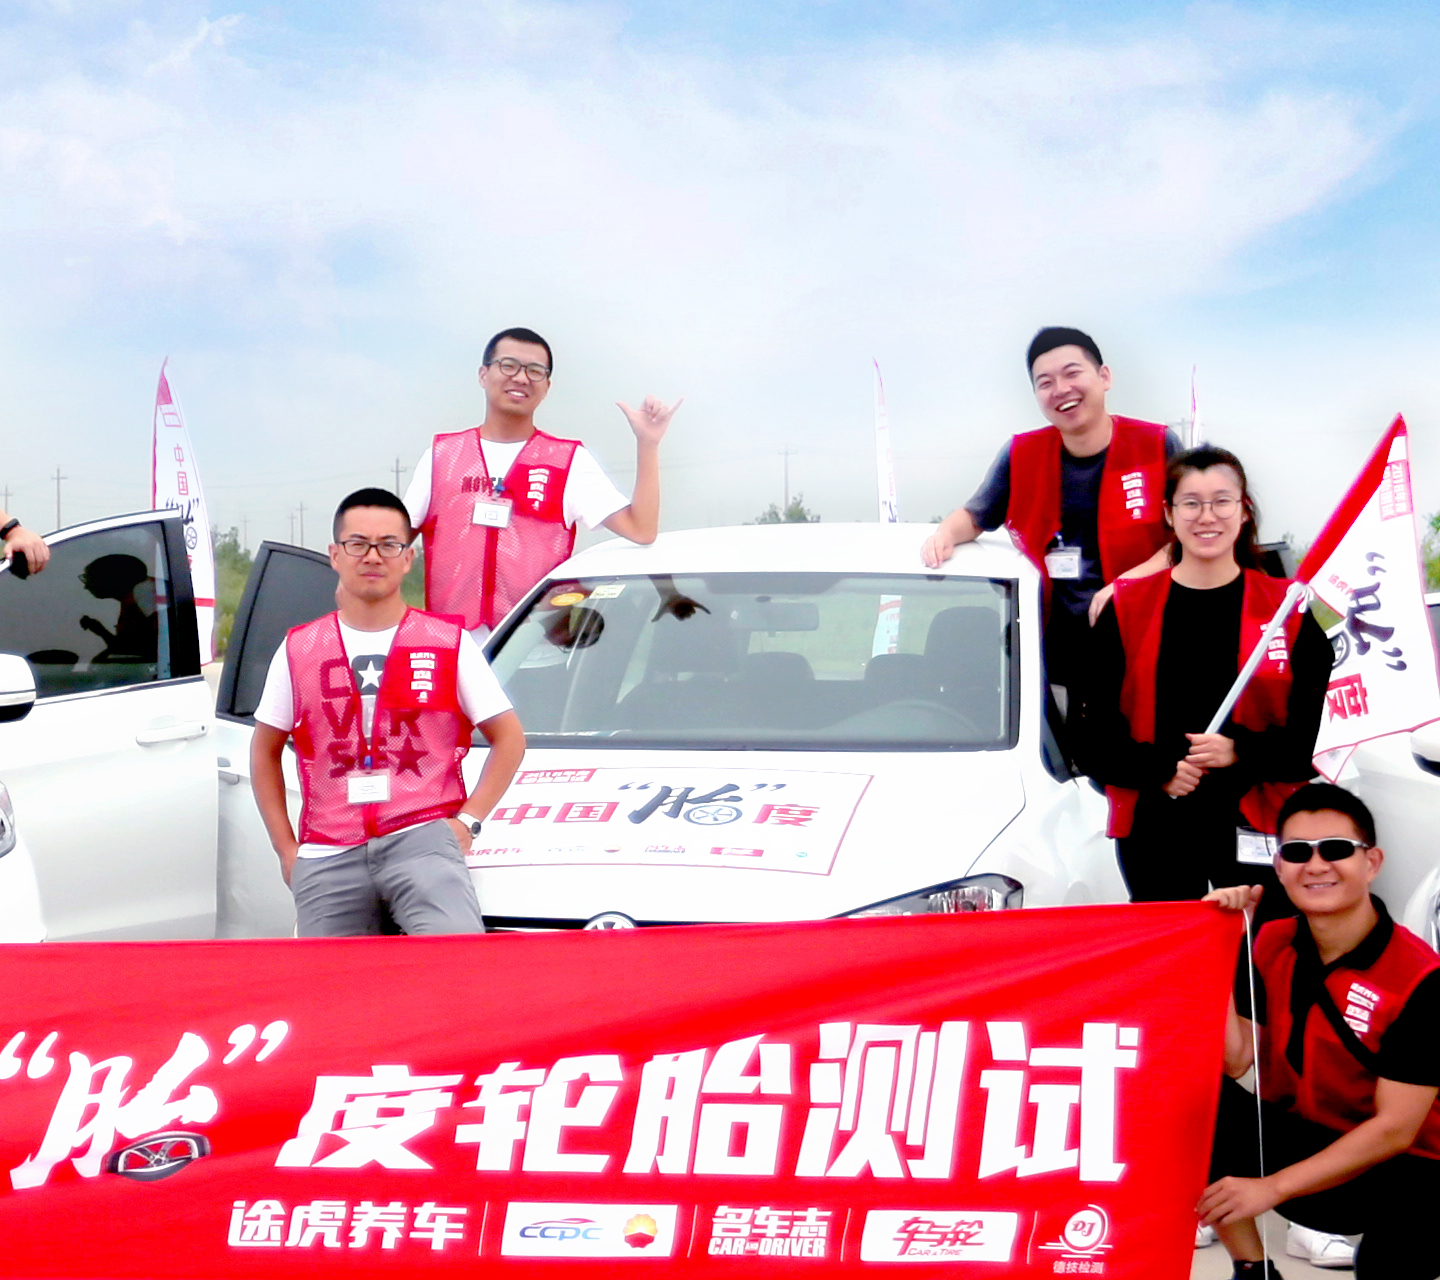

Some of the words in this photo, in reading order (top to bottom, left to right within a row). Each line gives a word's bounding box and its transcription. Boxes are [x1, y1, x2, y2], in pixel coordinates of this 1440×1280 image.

[227, 1198, 469, 1252] 途虎养车
[712, 1205, 833, 1238] 名车志
[708, 1237, 745, 1256] CAR
[758, 1237, 827, 1258] DRIVER
[1052, 1260, 1104, 1274] 德技检测
